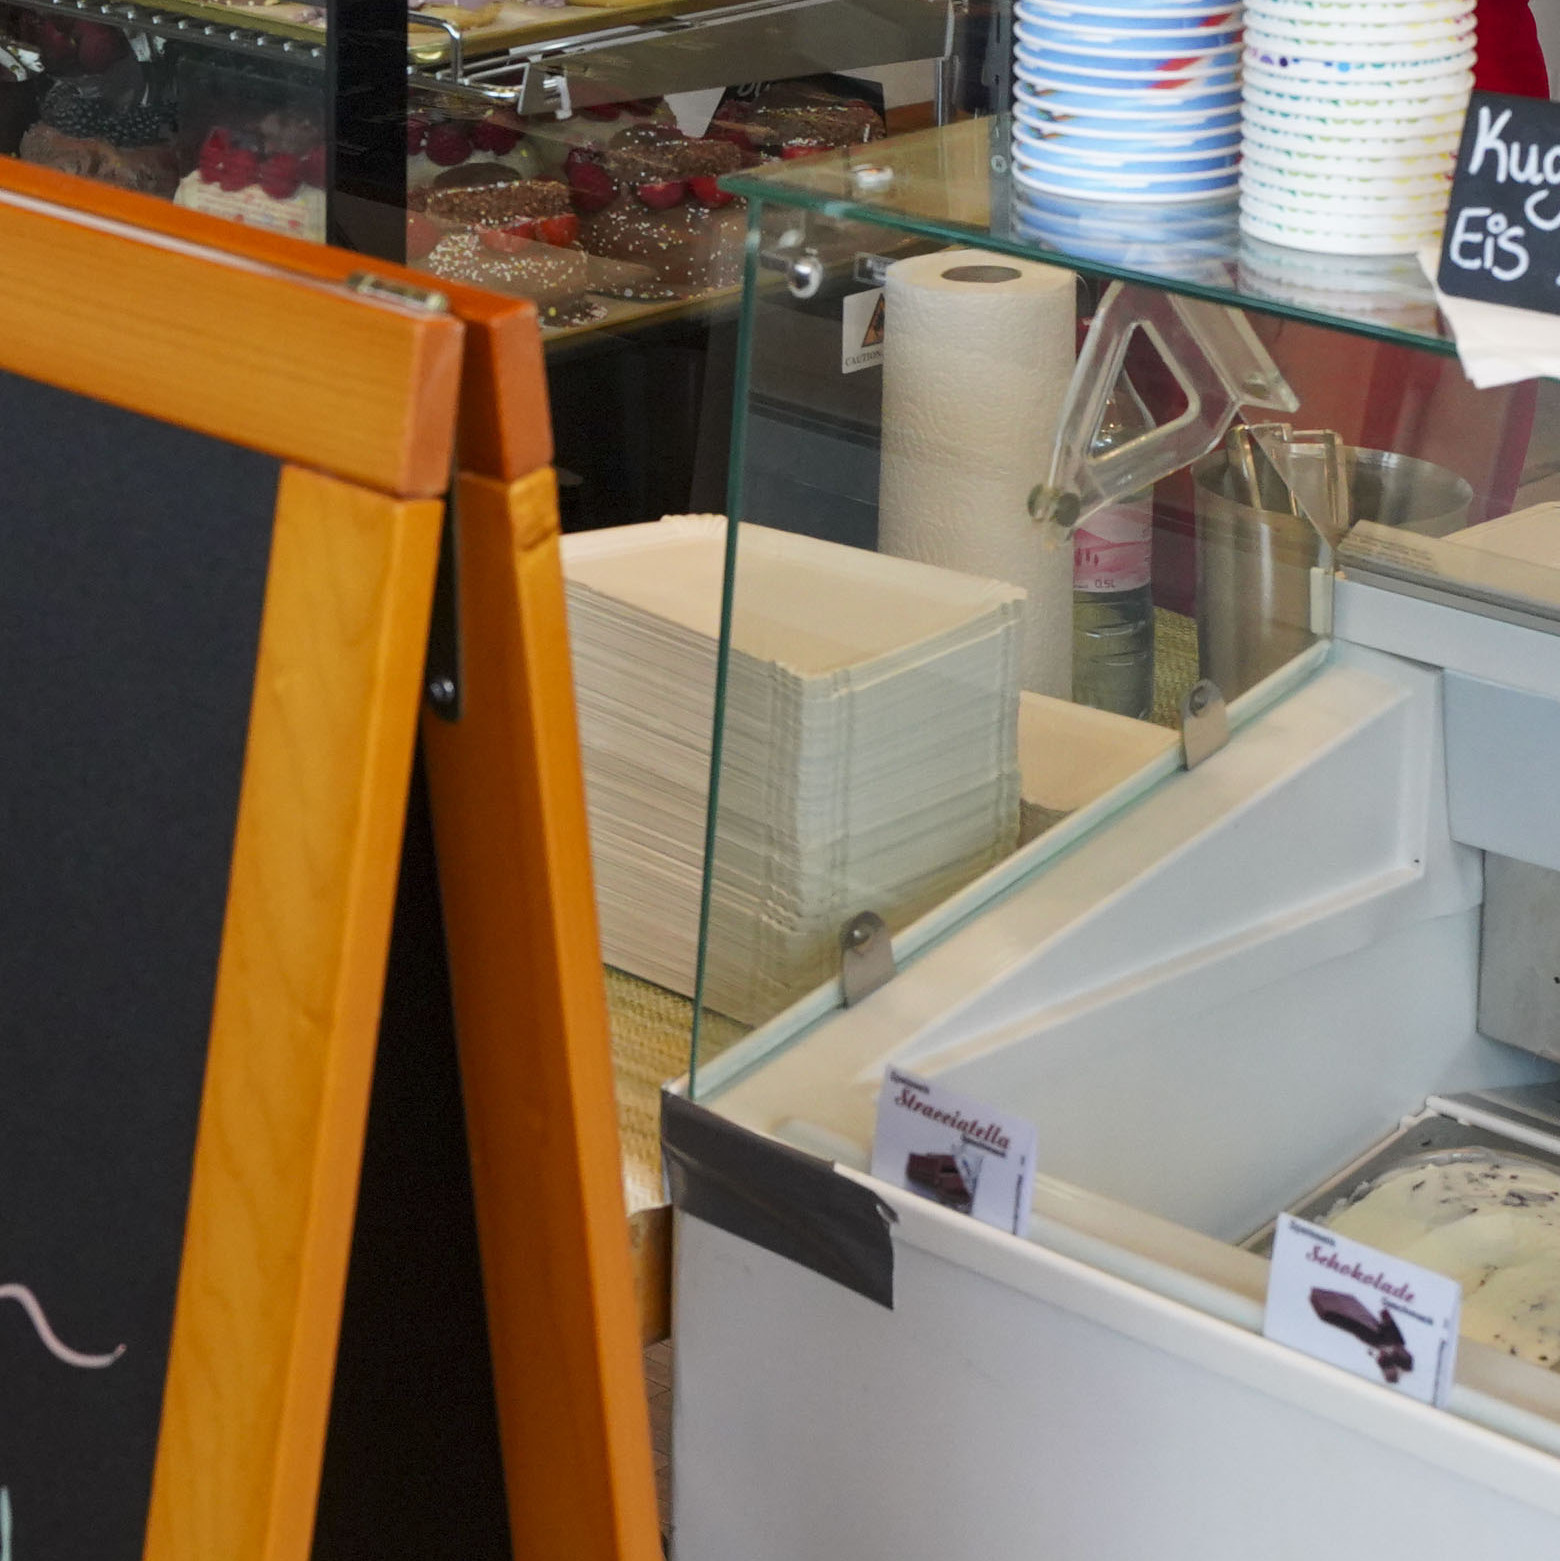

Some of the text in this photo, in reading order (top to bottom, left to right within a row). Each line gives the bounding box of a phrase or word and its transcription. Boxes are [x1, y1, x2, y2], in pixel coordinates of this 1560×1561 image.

[1449, 207, 1529, 281] Eis
[894, 1088, 1011, 1149] Stracciatella
[1305, 1245, 1414, 1302] Schokolade
